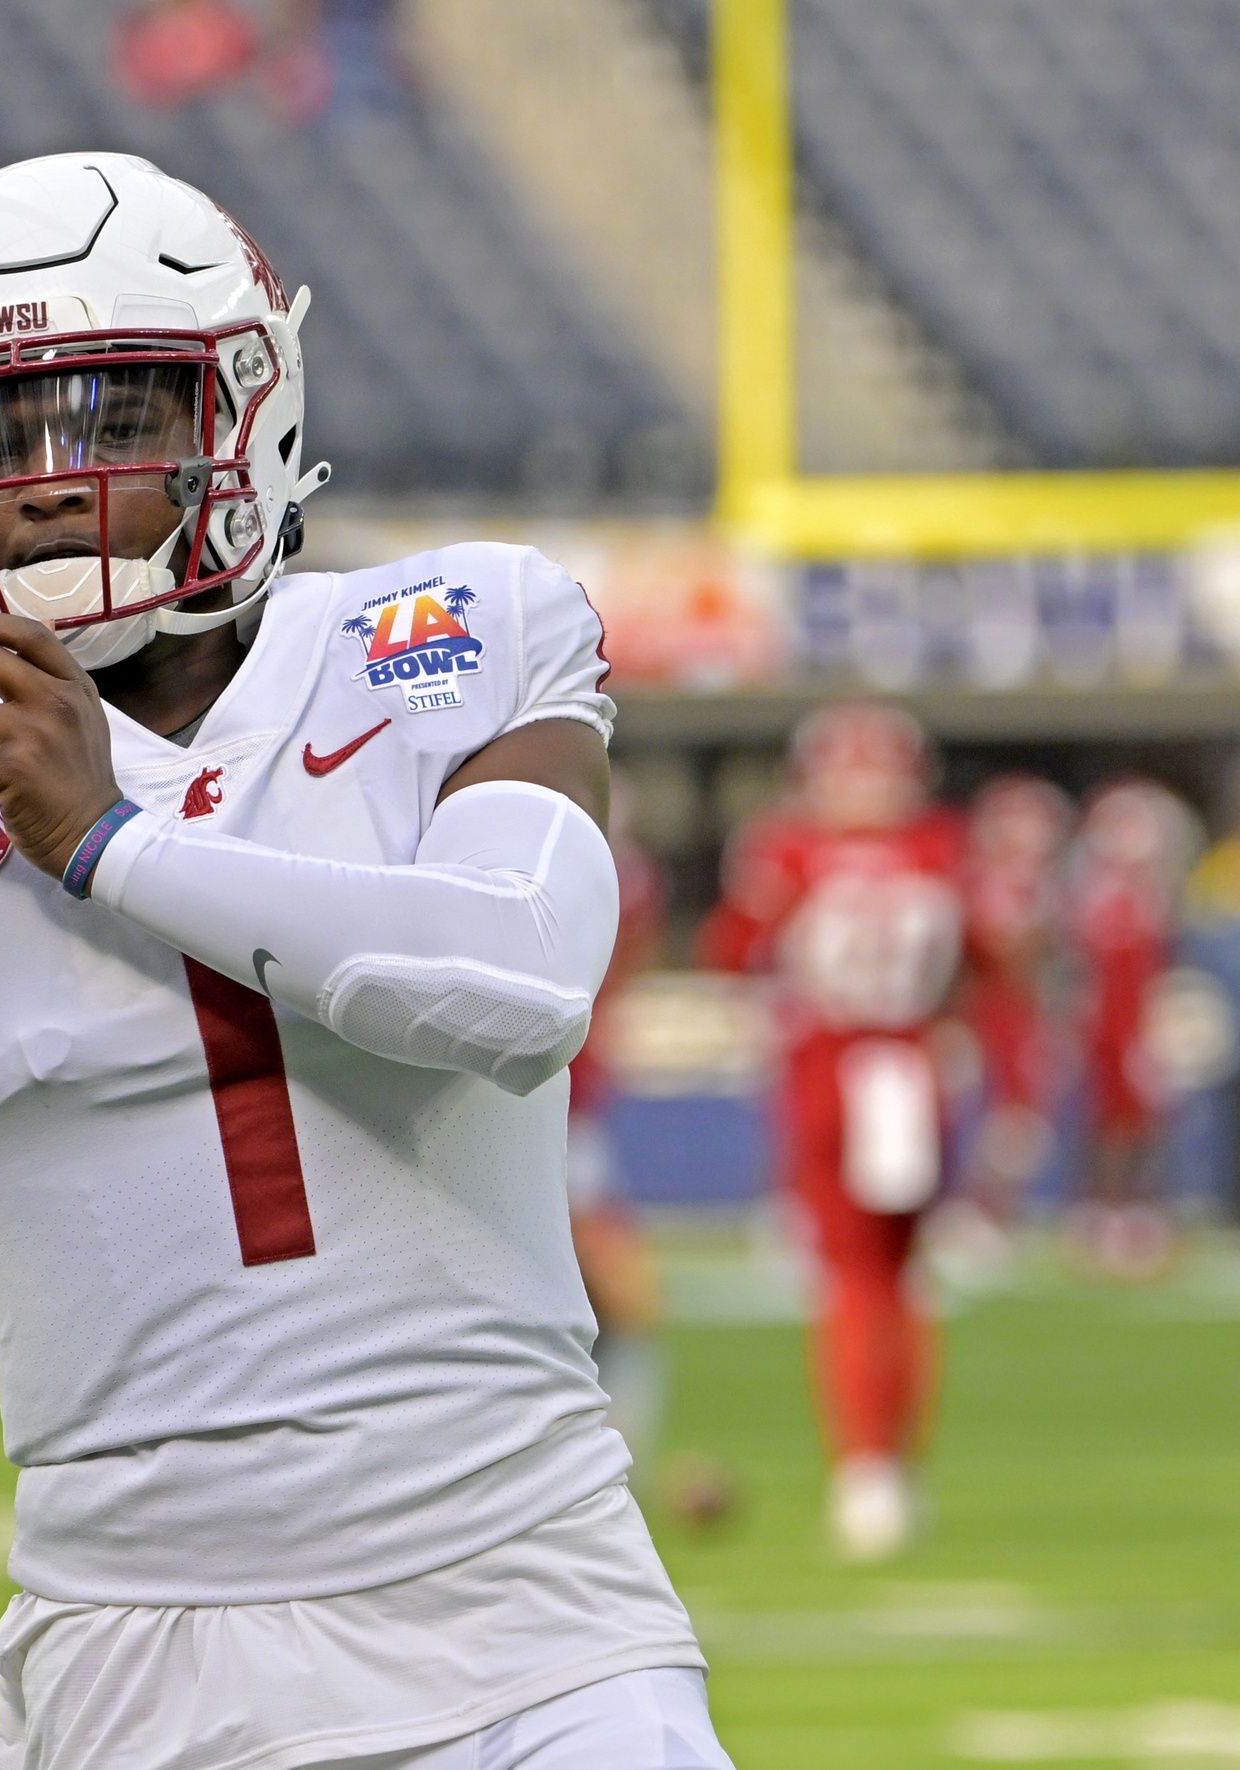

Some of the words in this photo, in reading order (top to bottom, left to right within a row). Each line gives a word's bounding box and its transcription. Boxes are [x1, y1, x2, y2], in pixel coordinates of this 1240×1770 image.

[361, 590, 399, 612] JIMMY
[401, 575, 446, 598] KIMMEL
[366, 594, 470, 662] LA
[368, 650, 479, 687] BOWL
[411, 680, 441, 690] PRESENTED
[408, 691, 462, 711] STIFEL
[78, 821, 113, 863] NICOLE
[181, 952, 316, 1267] 1
